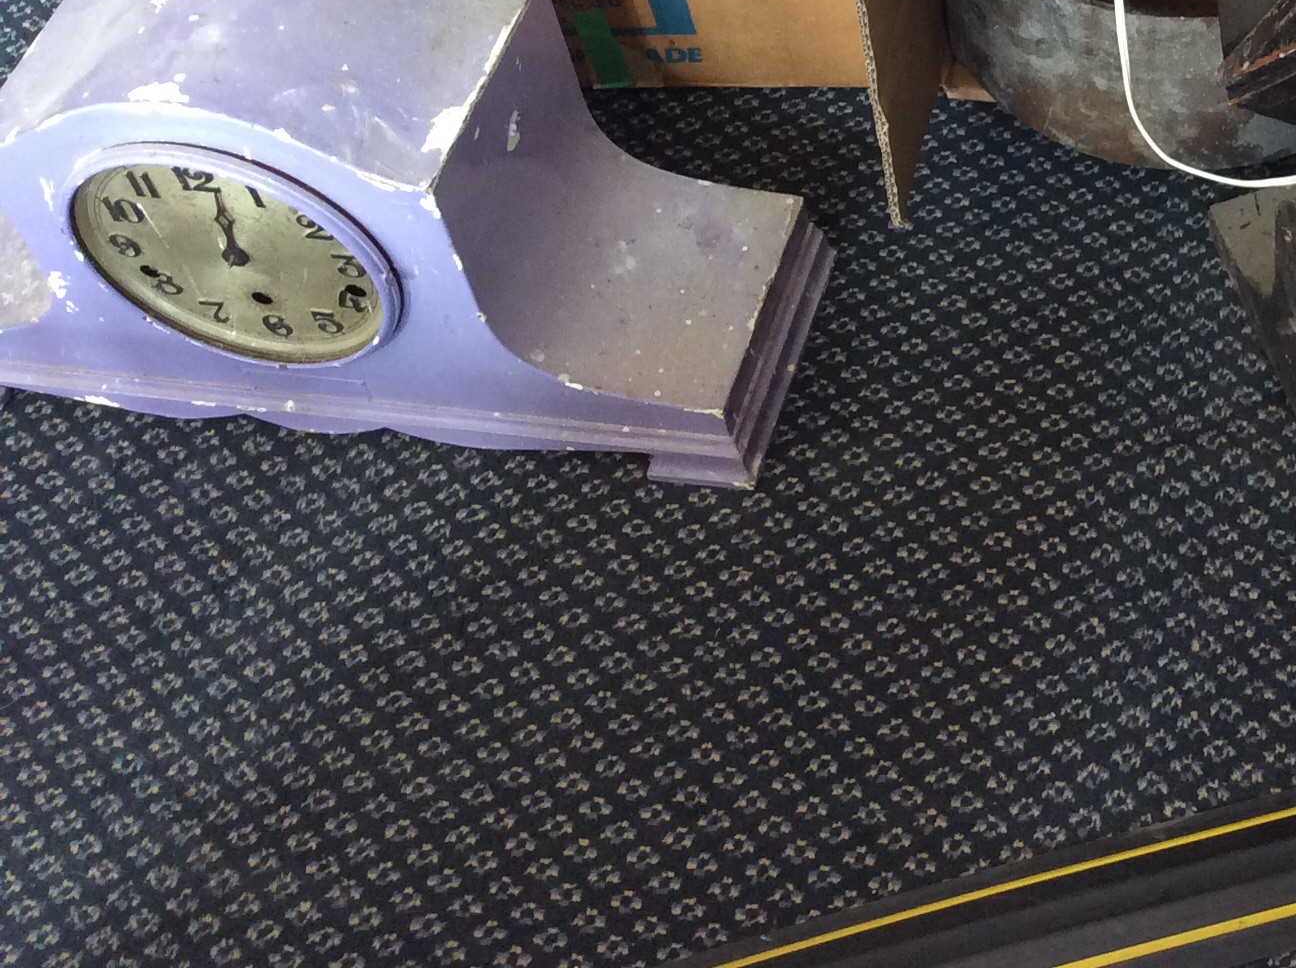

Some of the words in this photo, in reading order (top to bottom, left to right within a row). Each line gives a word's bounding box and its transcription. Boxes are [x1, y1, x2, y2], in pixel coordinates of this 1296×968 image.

[124, 170, 161, 199] 11
[172, 165, 221, 193] 12
[245, 185, 266, 208] 1
[101, 195, 145, 224] 10
[295, 213, 334, 241] 2
[109, 233, 142, 258] 9
[330, 253, 366, 278] 3
[151, 272, 183, 296] 8
[198, 298, 231, 323] 7
[309, 308, 345, 335] 5
[261, 314, 294, 338] 6
